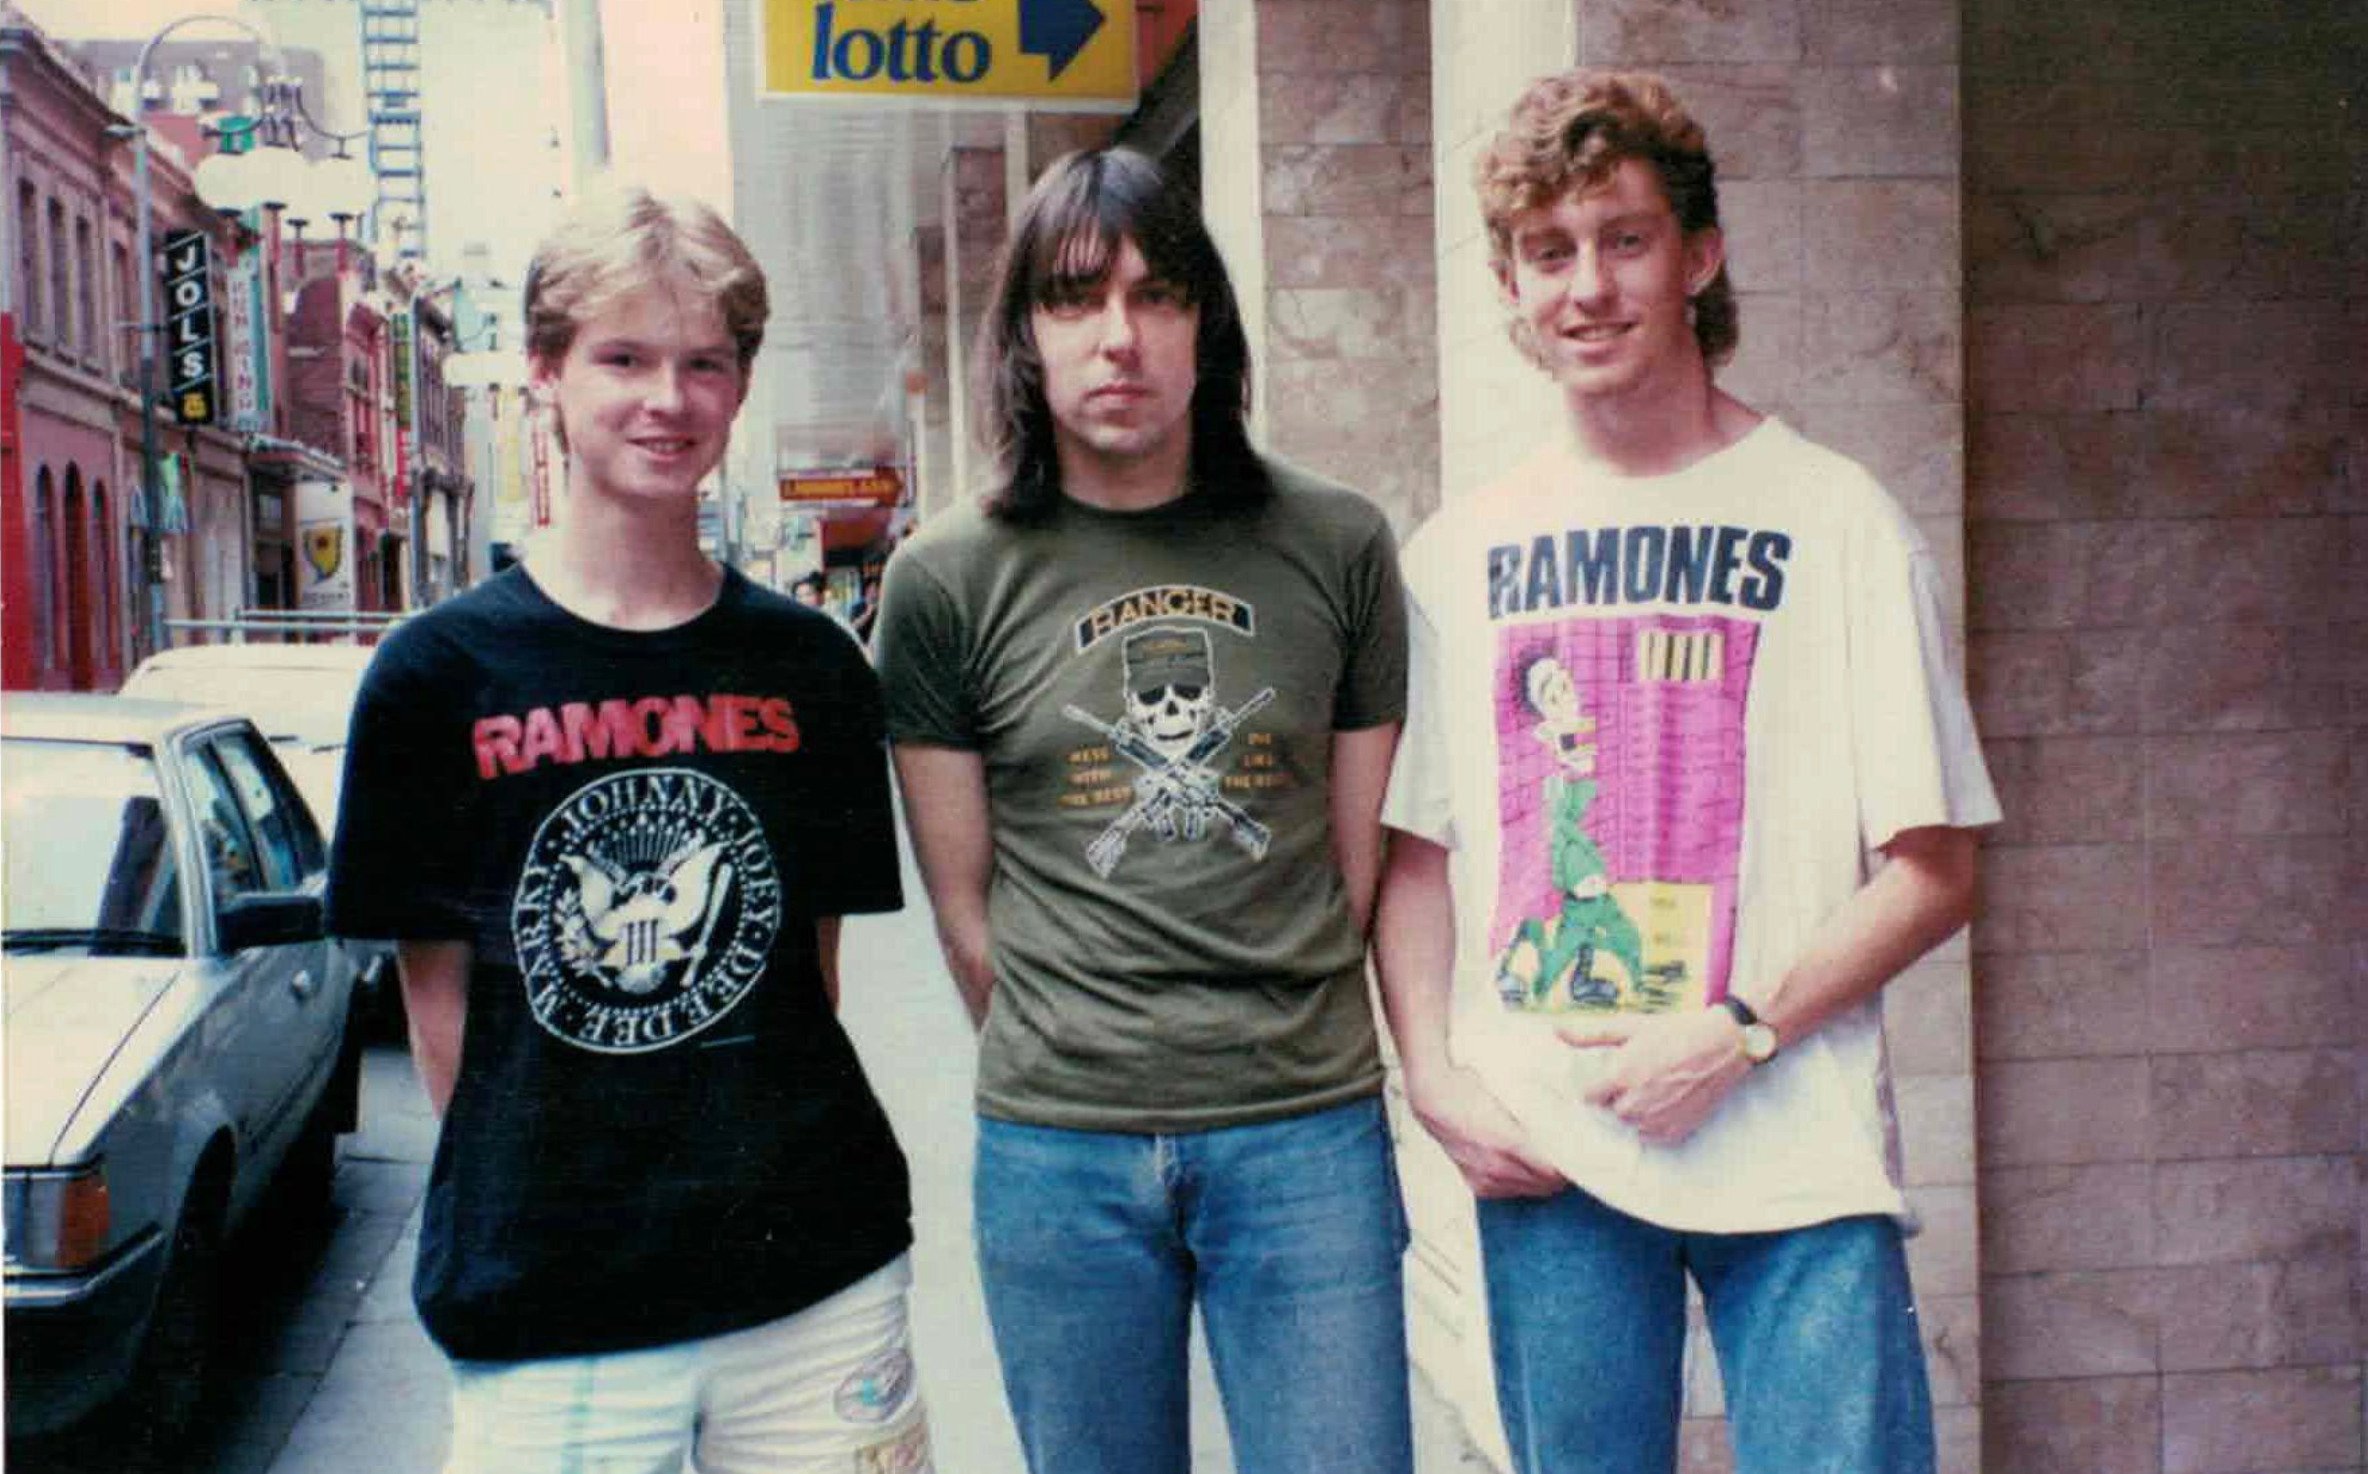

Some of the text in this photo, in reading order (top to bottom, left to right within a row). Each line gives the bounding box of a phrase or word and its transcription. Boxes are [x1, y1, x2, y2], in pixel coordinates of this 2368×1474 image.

[811, 2, 993, 84] lotto
[1487, 524, 1792, 620] RAMONES
[474, 693, 799, 779] RAMONES
[560, 774, 724, 843] JOHNNY
[733, 826, 778, 934] JOEY
[578, 1007, 676, 1045] DEE
[684, 947, 766, 1026] DEE
